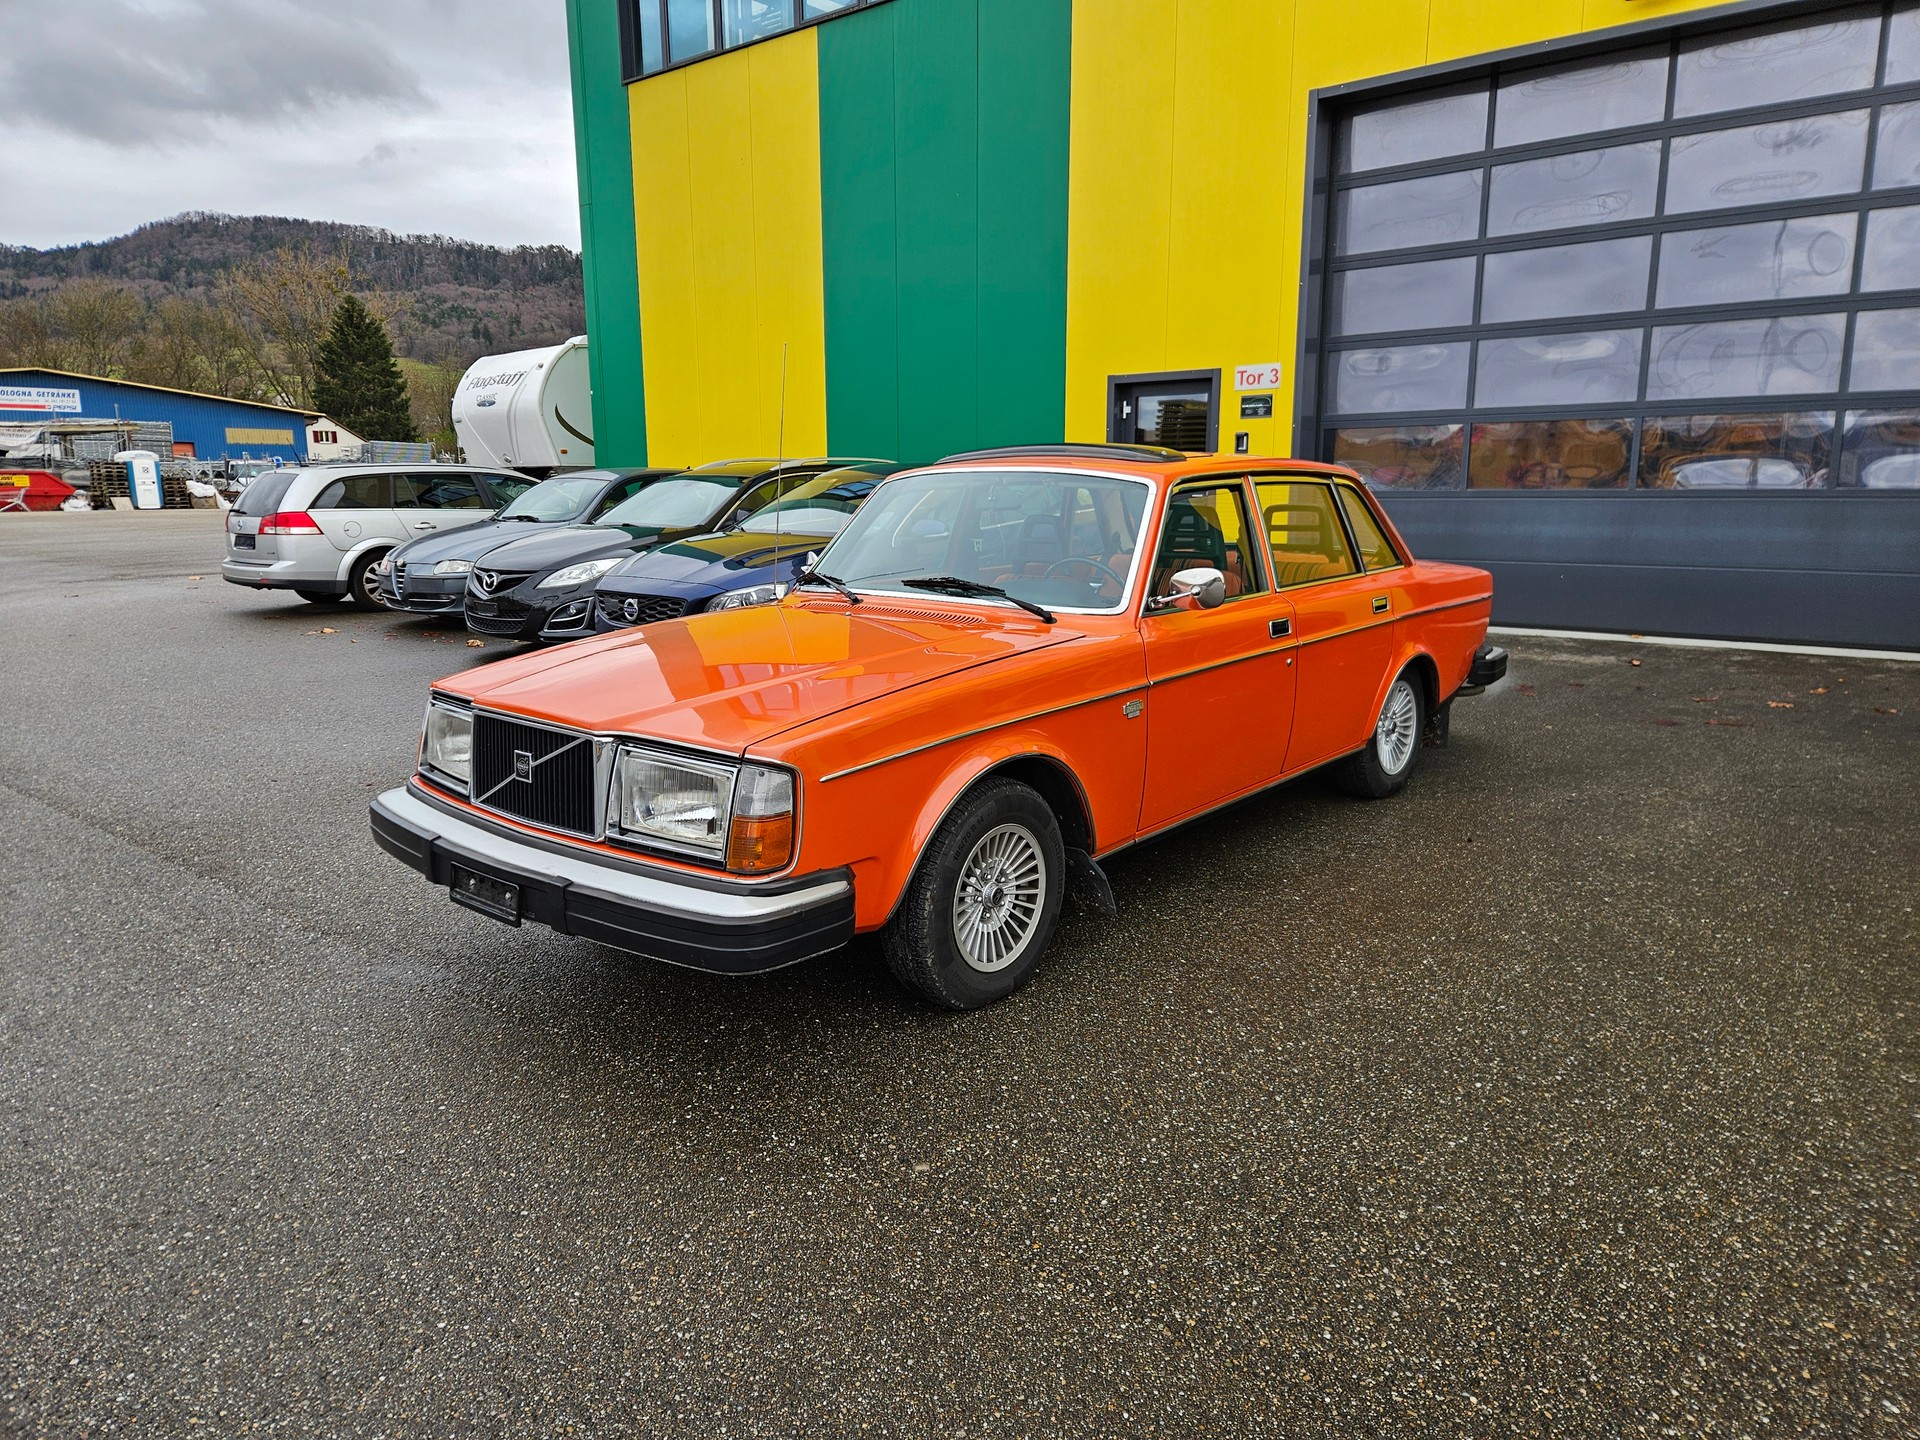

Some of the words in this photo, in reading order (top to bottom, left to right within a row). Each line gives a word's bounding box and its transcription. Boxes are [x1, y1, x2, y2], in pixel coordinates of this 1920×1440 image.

[465, 371, 527, 391] Flagstaff
[1237, 370, 1264, 386] Tor
[1269, 368, 1279, 384] 3
